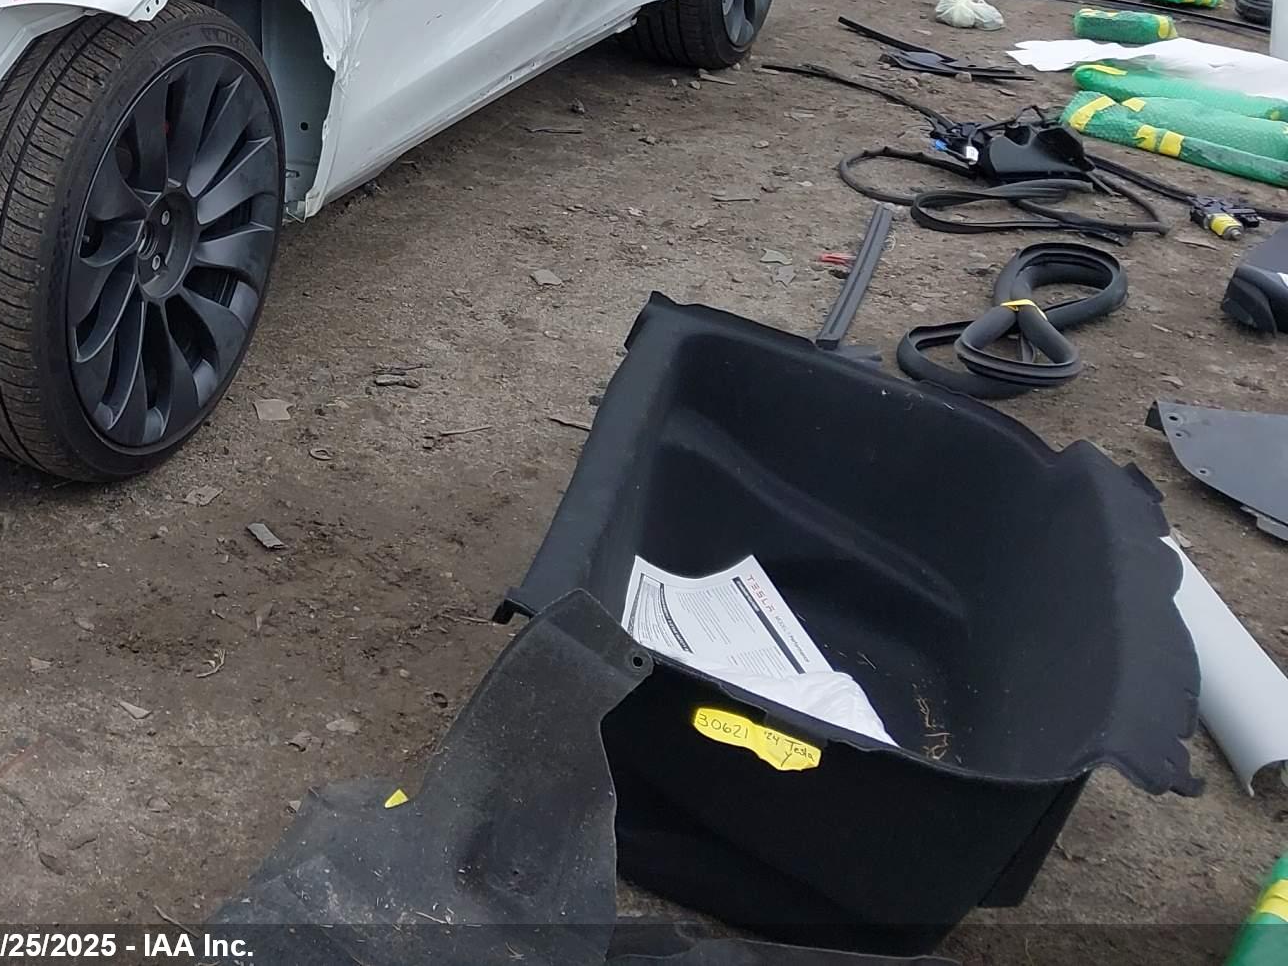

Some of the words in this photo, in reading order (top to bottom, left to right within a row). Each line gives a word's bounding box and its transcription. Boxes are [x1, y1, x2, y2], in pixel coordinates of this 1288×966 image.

[746, 574, 776, 614] TESLA
[697, 713, 749, 739] 30621
[784, 738, 815, 762] Tesla
